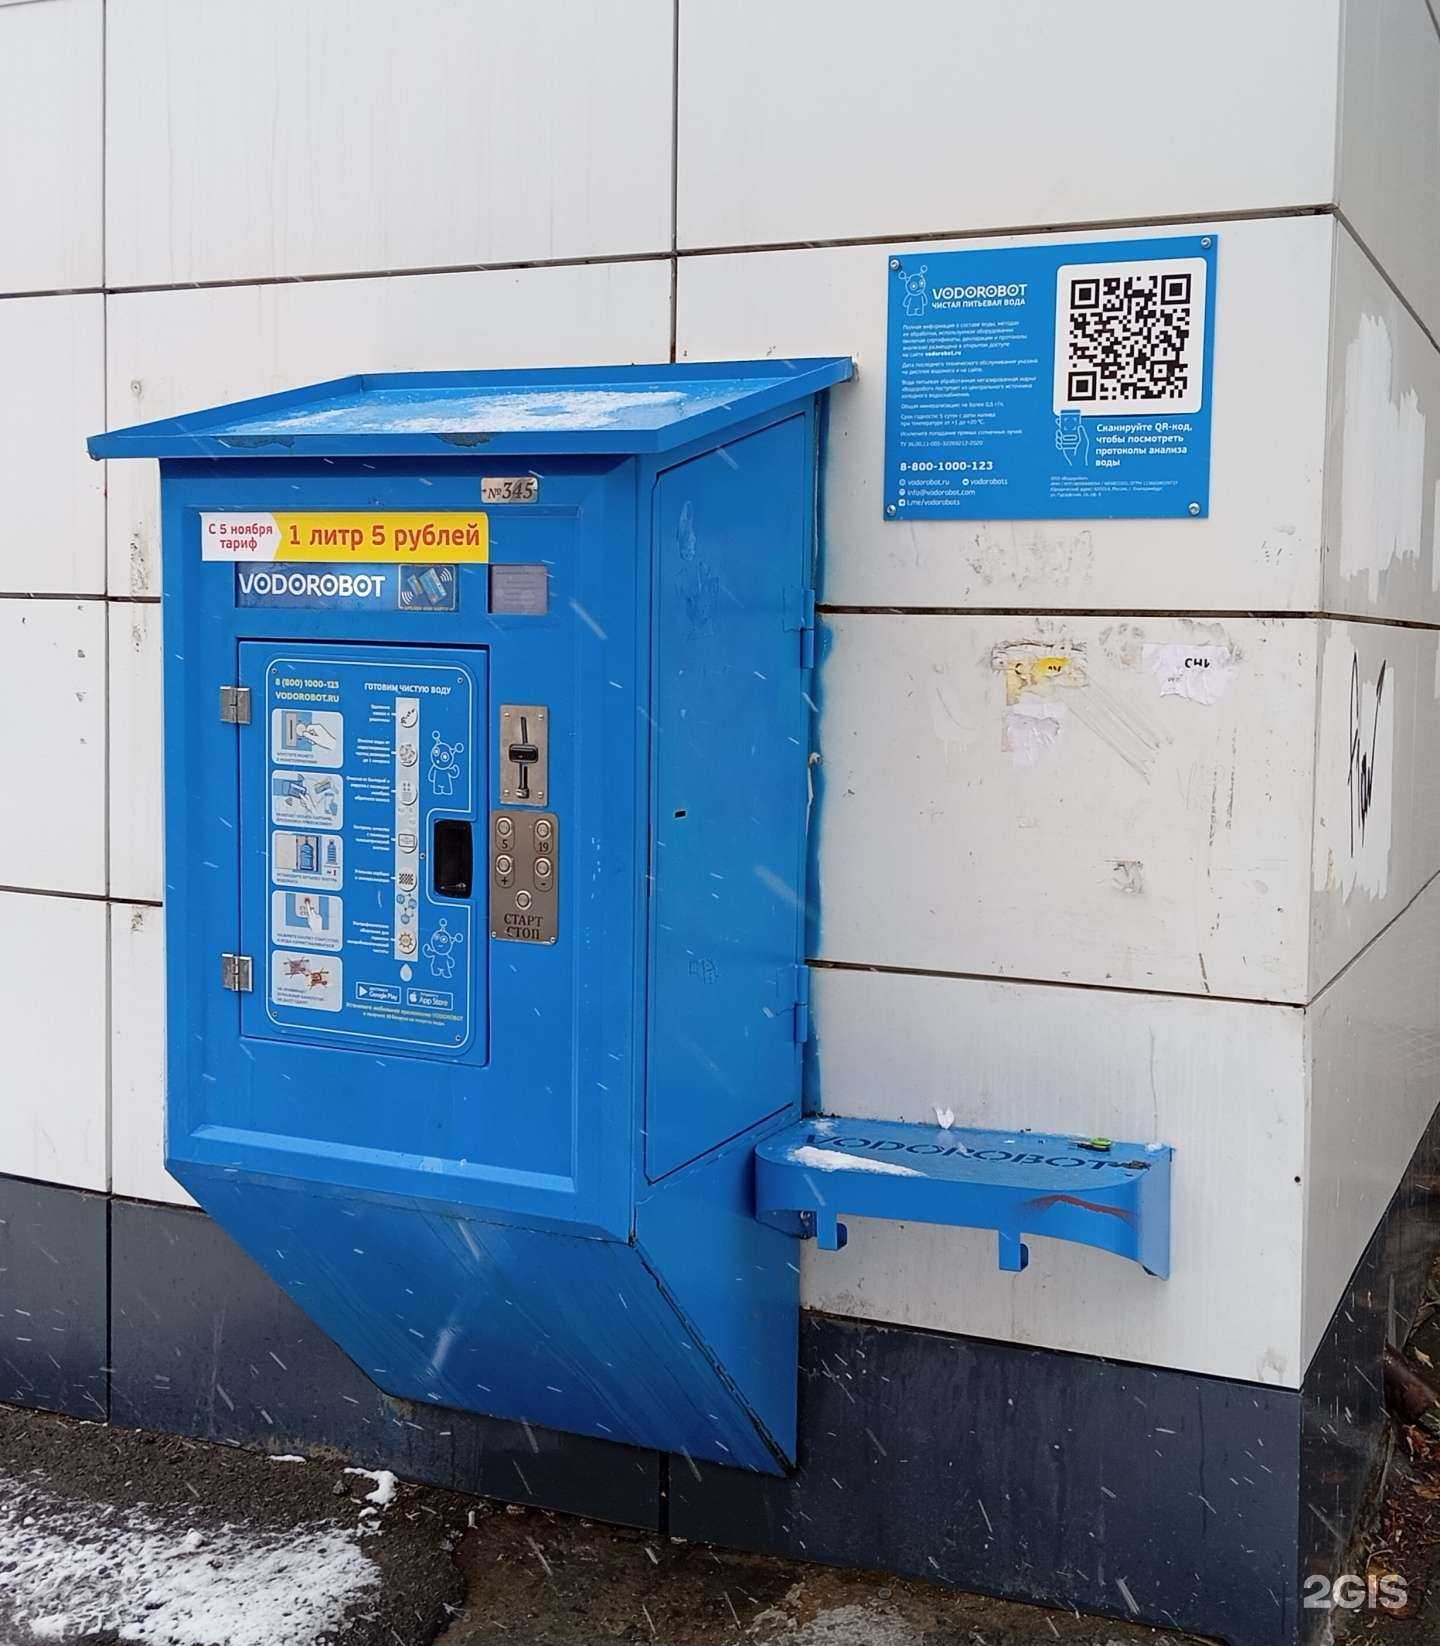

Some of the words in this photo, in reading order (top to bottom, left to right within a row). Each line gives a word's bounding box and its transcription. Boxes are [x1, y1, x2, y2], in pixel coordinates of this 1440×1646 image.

[932, 284, 1028, 300] VODOROBOT
[932, 300, 961, 309] ЧИСТАЯ
[962, 299, 1002, 308] ПИТЬЕВАЯ
[1003, 298, 1026, 306] ВОДА
[1097, 423, 1152, 435] Сканируйте
[1096, 435, 1125, 444] чтобы
[1128, 435, 1184, 444] посмотреть
[1096, 446, 1147, 456] протоколы
[1149, 446, 1188, 454] анализа
[900, 461, 994, 472] 8-800-1000-123
[1096, 459, 1121, 467] воды
[208, 524, 217, 535] С
[219, 524, 228, 535] 5
[231, 524, 273, 537] ноября
[289, 525, 300, 545] 1
[309, 528, 364, 551] литр
[371, 525, 386, 546] 5
[394, 523, 480, 551] рублей
[220, 537, 258, 552] тариф
[238, 573, 386, 598] VODOROBOT
[364, 683, 398, 691] ГОТОВИМ
[399, 684, 429, 693] ЧИСТУЮ
[431, 686, 451, 695] ВОДУ
[275, 691, 340, 703] VODOROBOT.RU
[501, 839, 508, 849] 5
[538, 842, 549, 852] 19
[503, 913, 544, 927] СТАРТ
[506, 925, 540, 940] СТОП
[805, 1134, 1116, 1171] VODOROBOT
